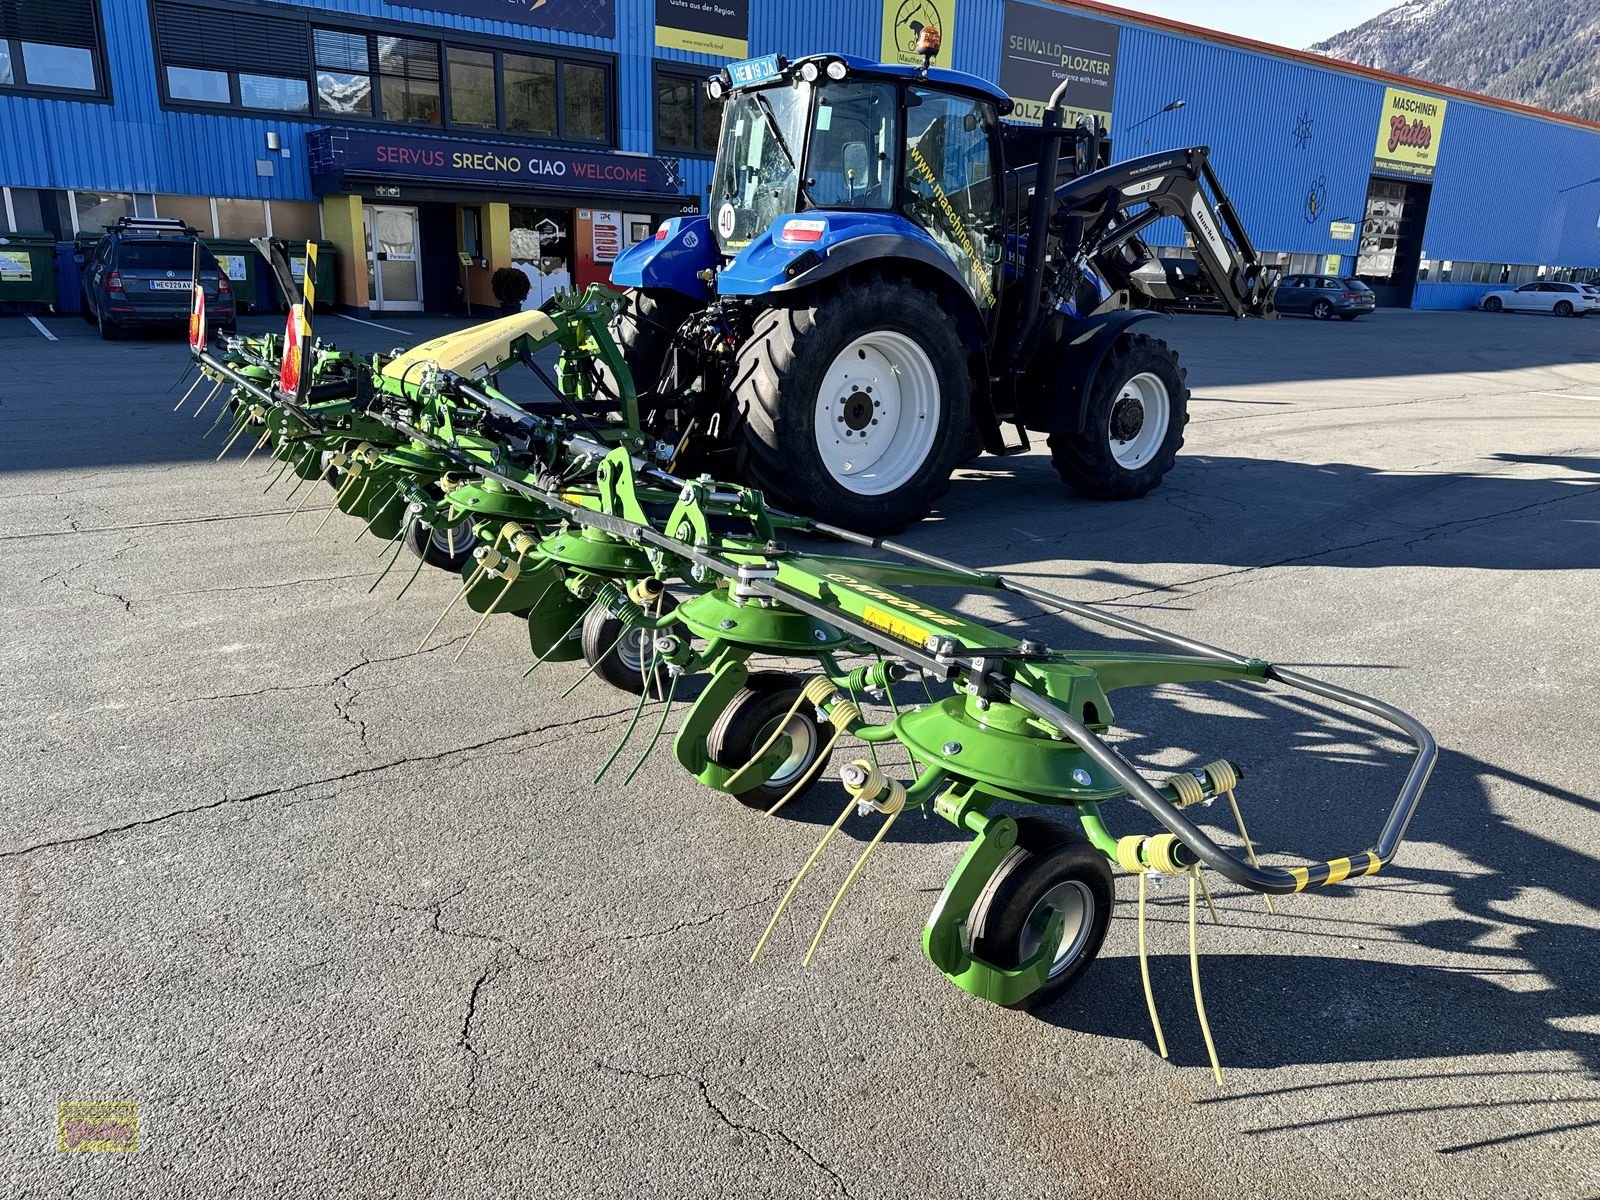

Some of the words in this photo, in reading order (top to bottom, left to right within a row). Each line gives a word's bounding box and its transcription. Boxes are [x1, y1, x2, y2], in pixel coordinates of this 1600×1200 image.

[702, 3, 712, 12] der
[714, 5, 736, 16] Region.
[1009, 35, 1062, 57] SEIWALD
[734, 66, 747, 82] HE
[752, 63, 759, 77] 19
[763, 60, 775, 77] JA
[1080, 76, 1091, 84] with
[1392, 96, 1438, 117] MASCHINEN
[1388, 114, 1432, 153] Gailer
[376, 146, 445, 167] SERVUS
[452, 151, 522, 173] SREČNO
[528, 158, 566, 176] CIAO
[572, 162, 647, 182] WELCOME
[1375, 161, 1433, 175] www.maschinen-gailer.at
[721, 210, 731, 231] 40
